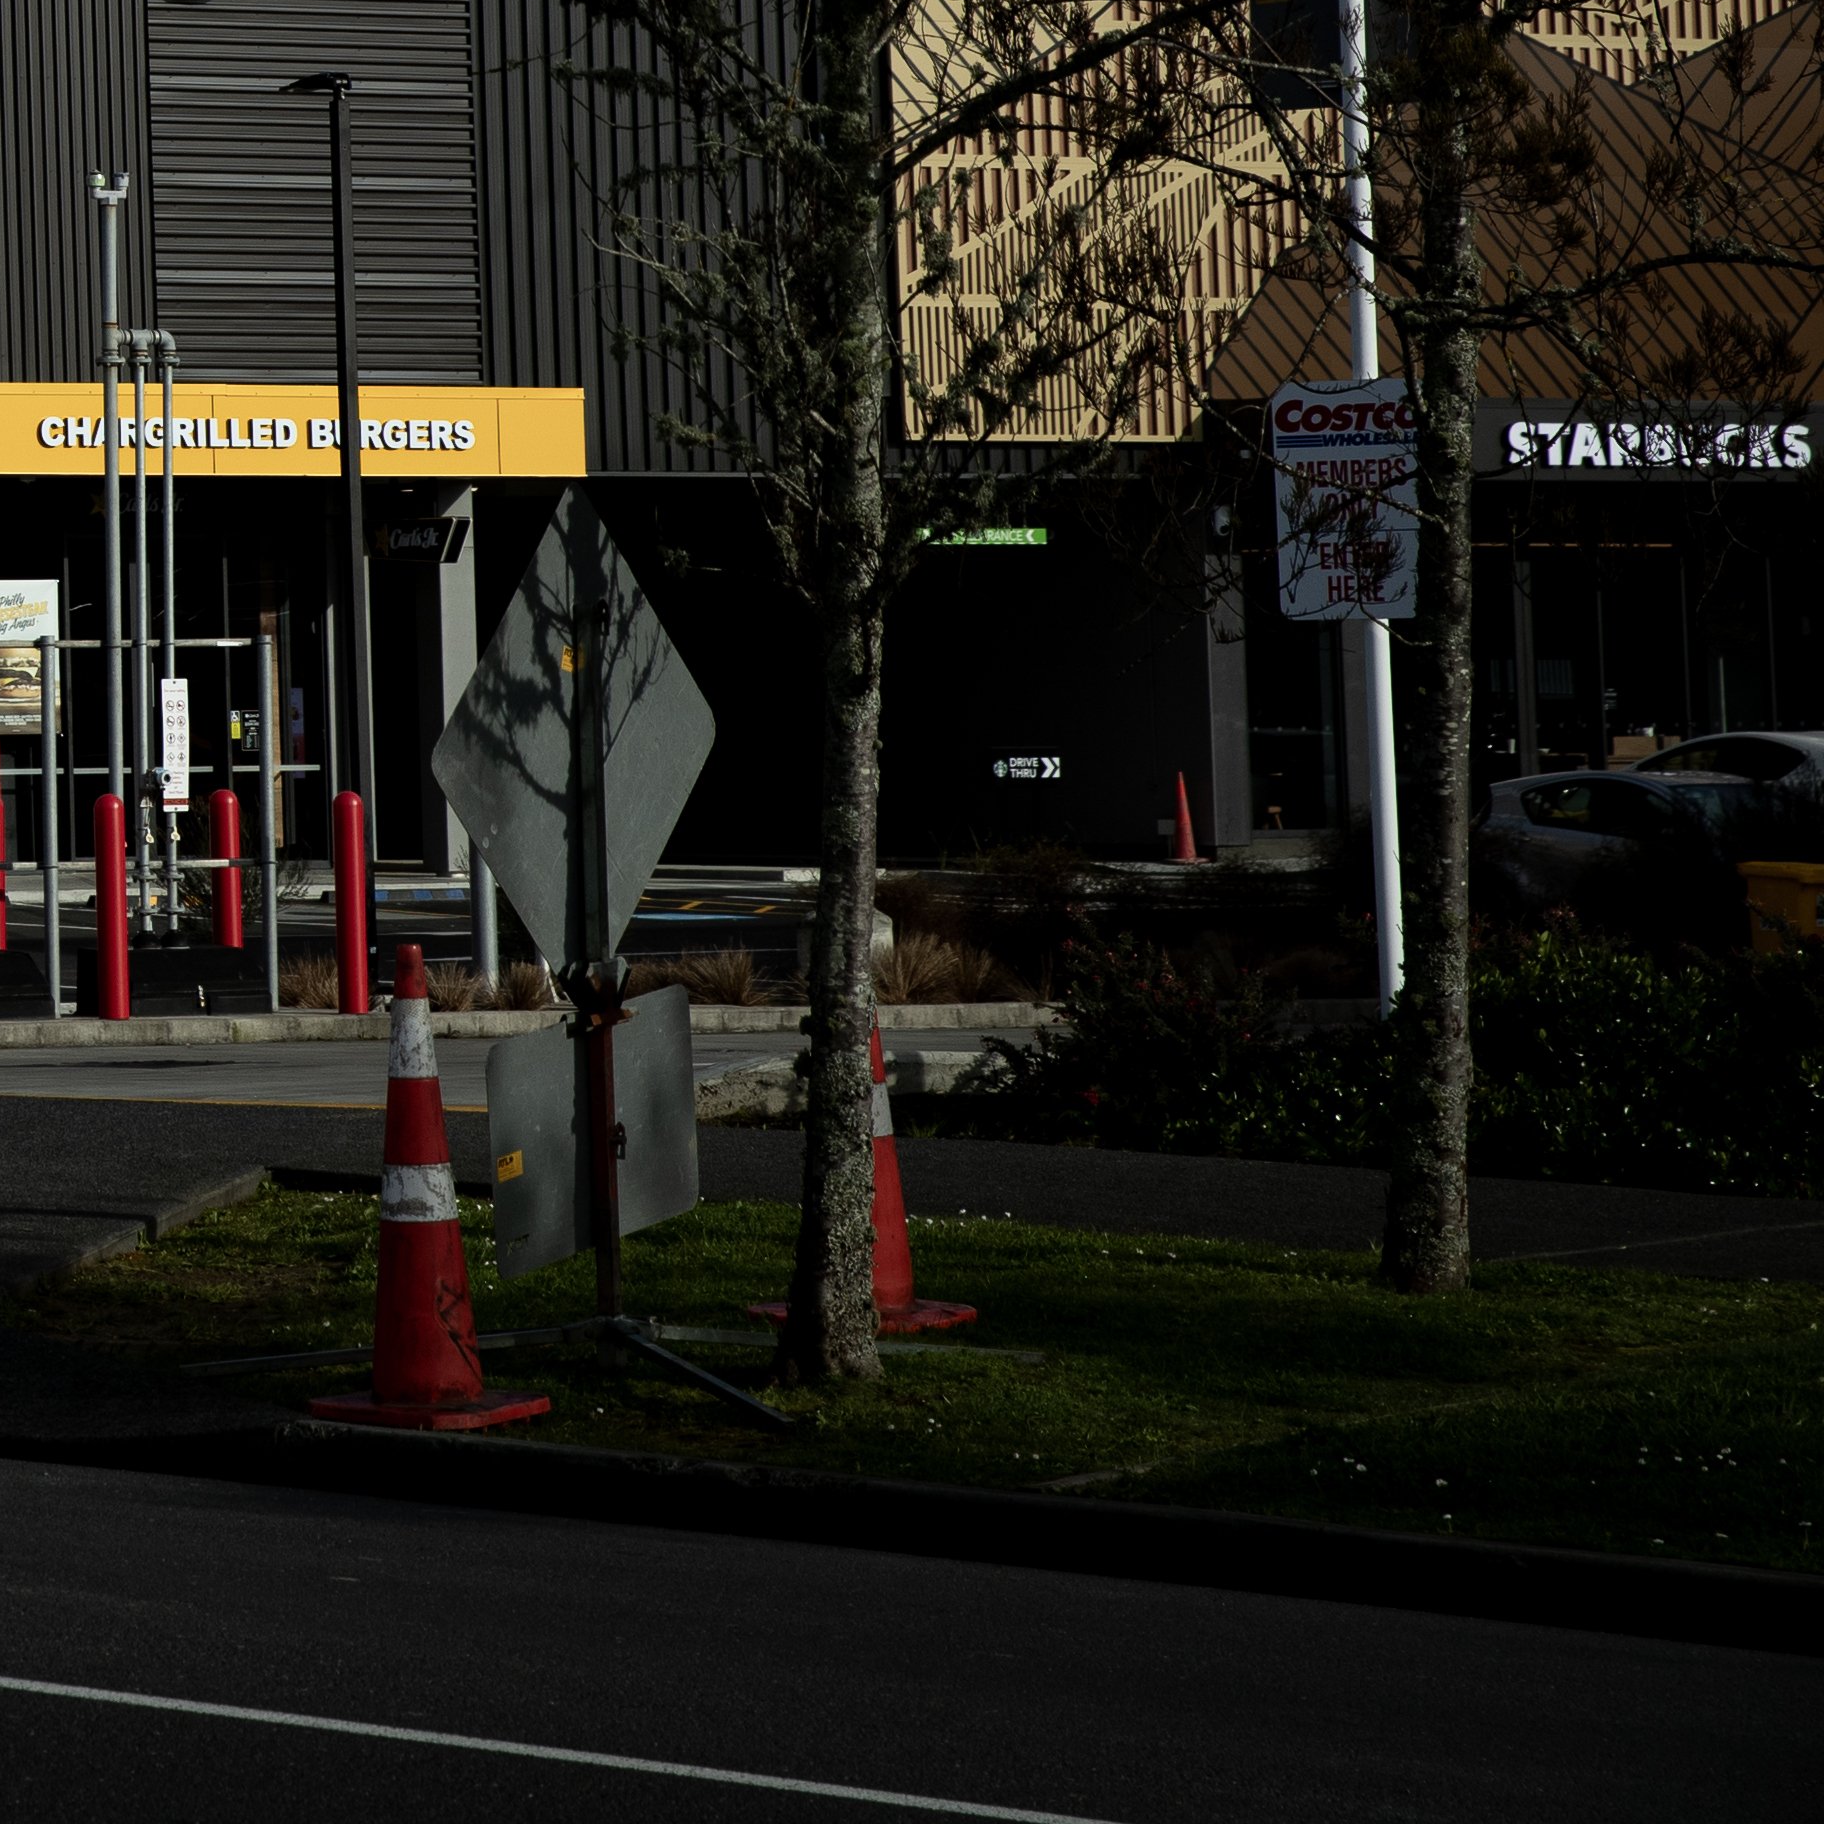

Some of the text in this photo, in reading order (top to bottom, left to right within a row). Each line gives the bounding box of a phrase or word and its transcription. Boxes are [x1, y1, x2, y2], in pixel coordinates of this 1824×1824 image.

[311, 419, 476, 451] BRGERS
[8, 618, 36, 632] Angus
[1008, 756, 1040, 767] DRIVE
[1009, 767, 1038, 779] THRU
